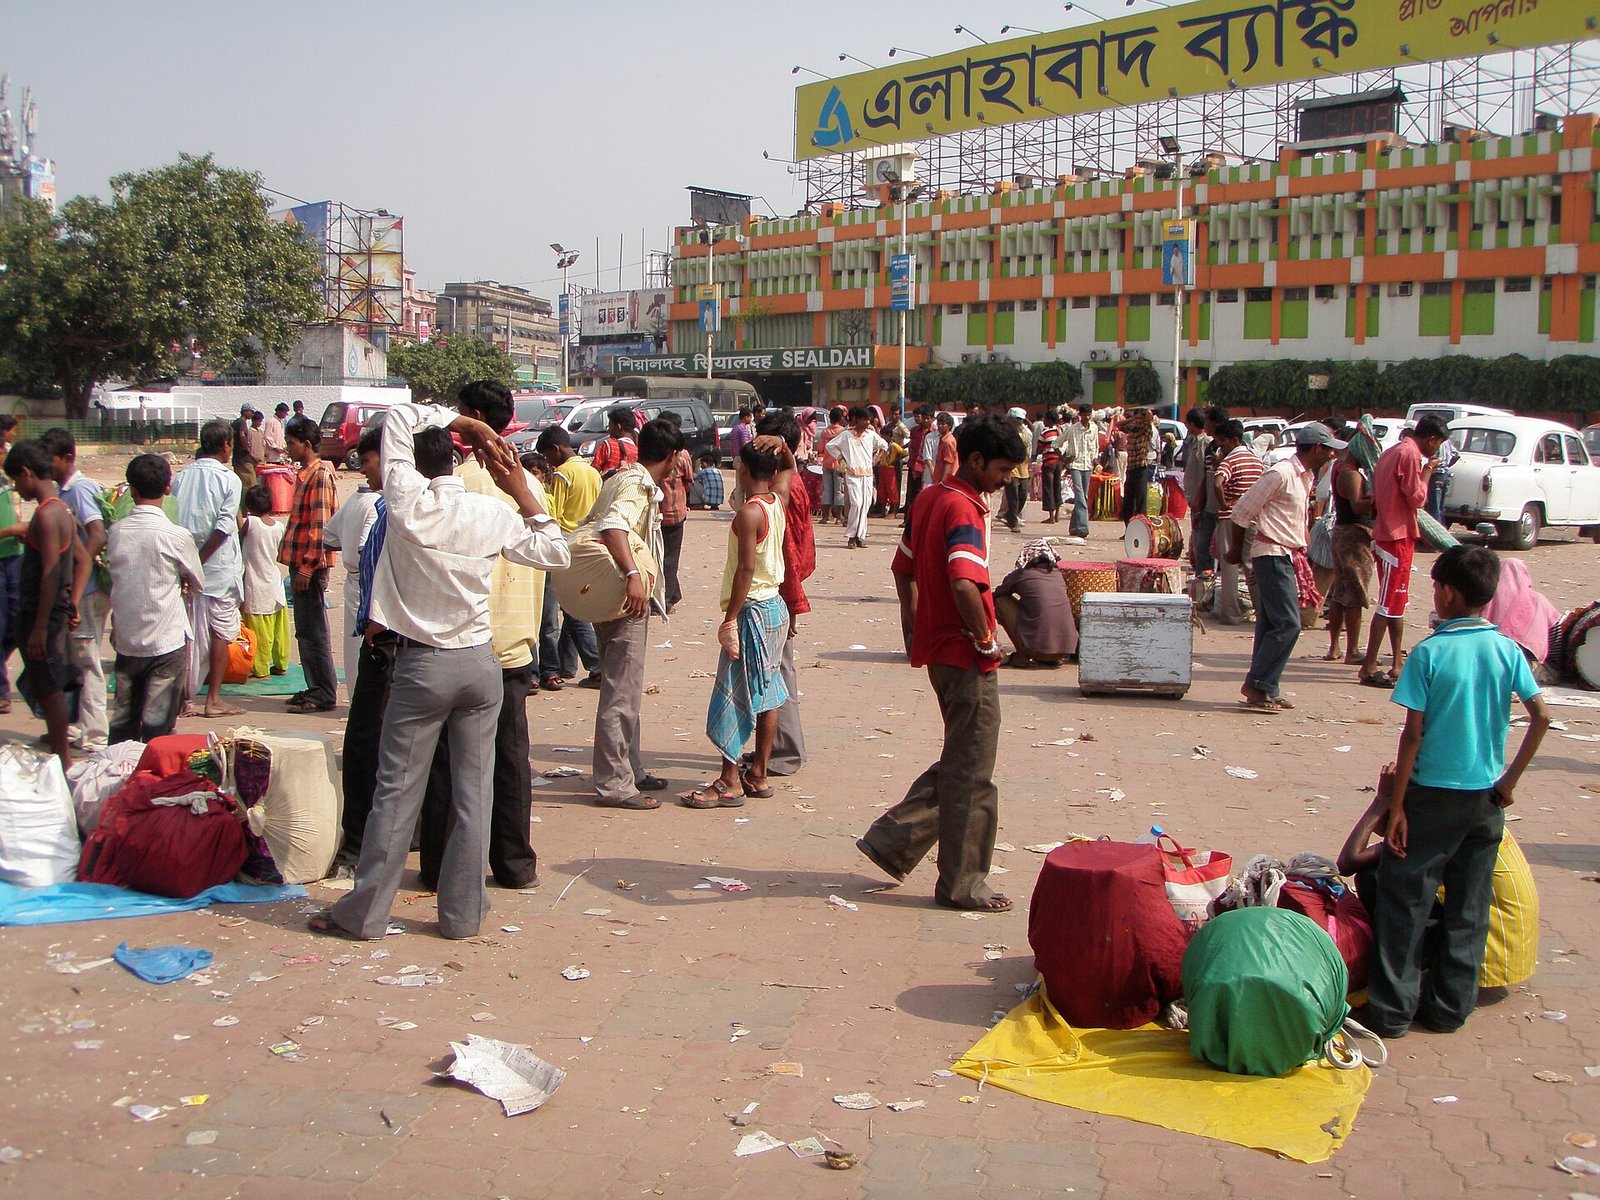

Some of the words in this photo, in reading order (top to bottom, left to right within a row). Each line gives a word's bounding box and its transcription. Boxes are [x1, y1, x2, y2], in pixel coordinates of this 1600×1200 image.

[862, 25, 1159, 130] এলাহাবাদ
[617, 356, 687, 371] শিয়ালদহ
[782, 348, 870, 367] SEALDAH
